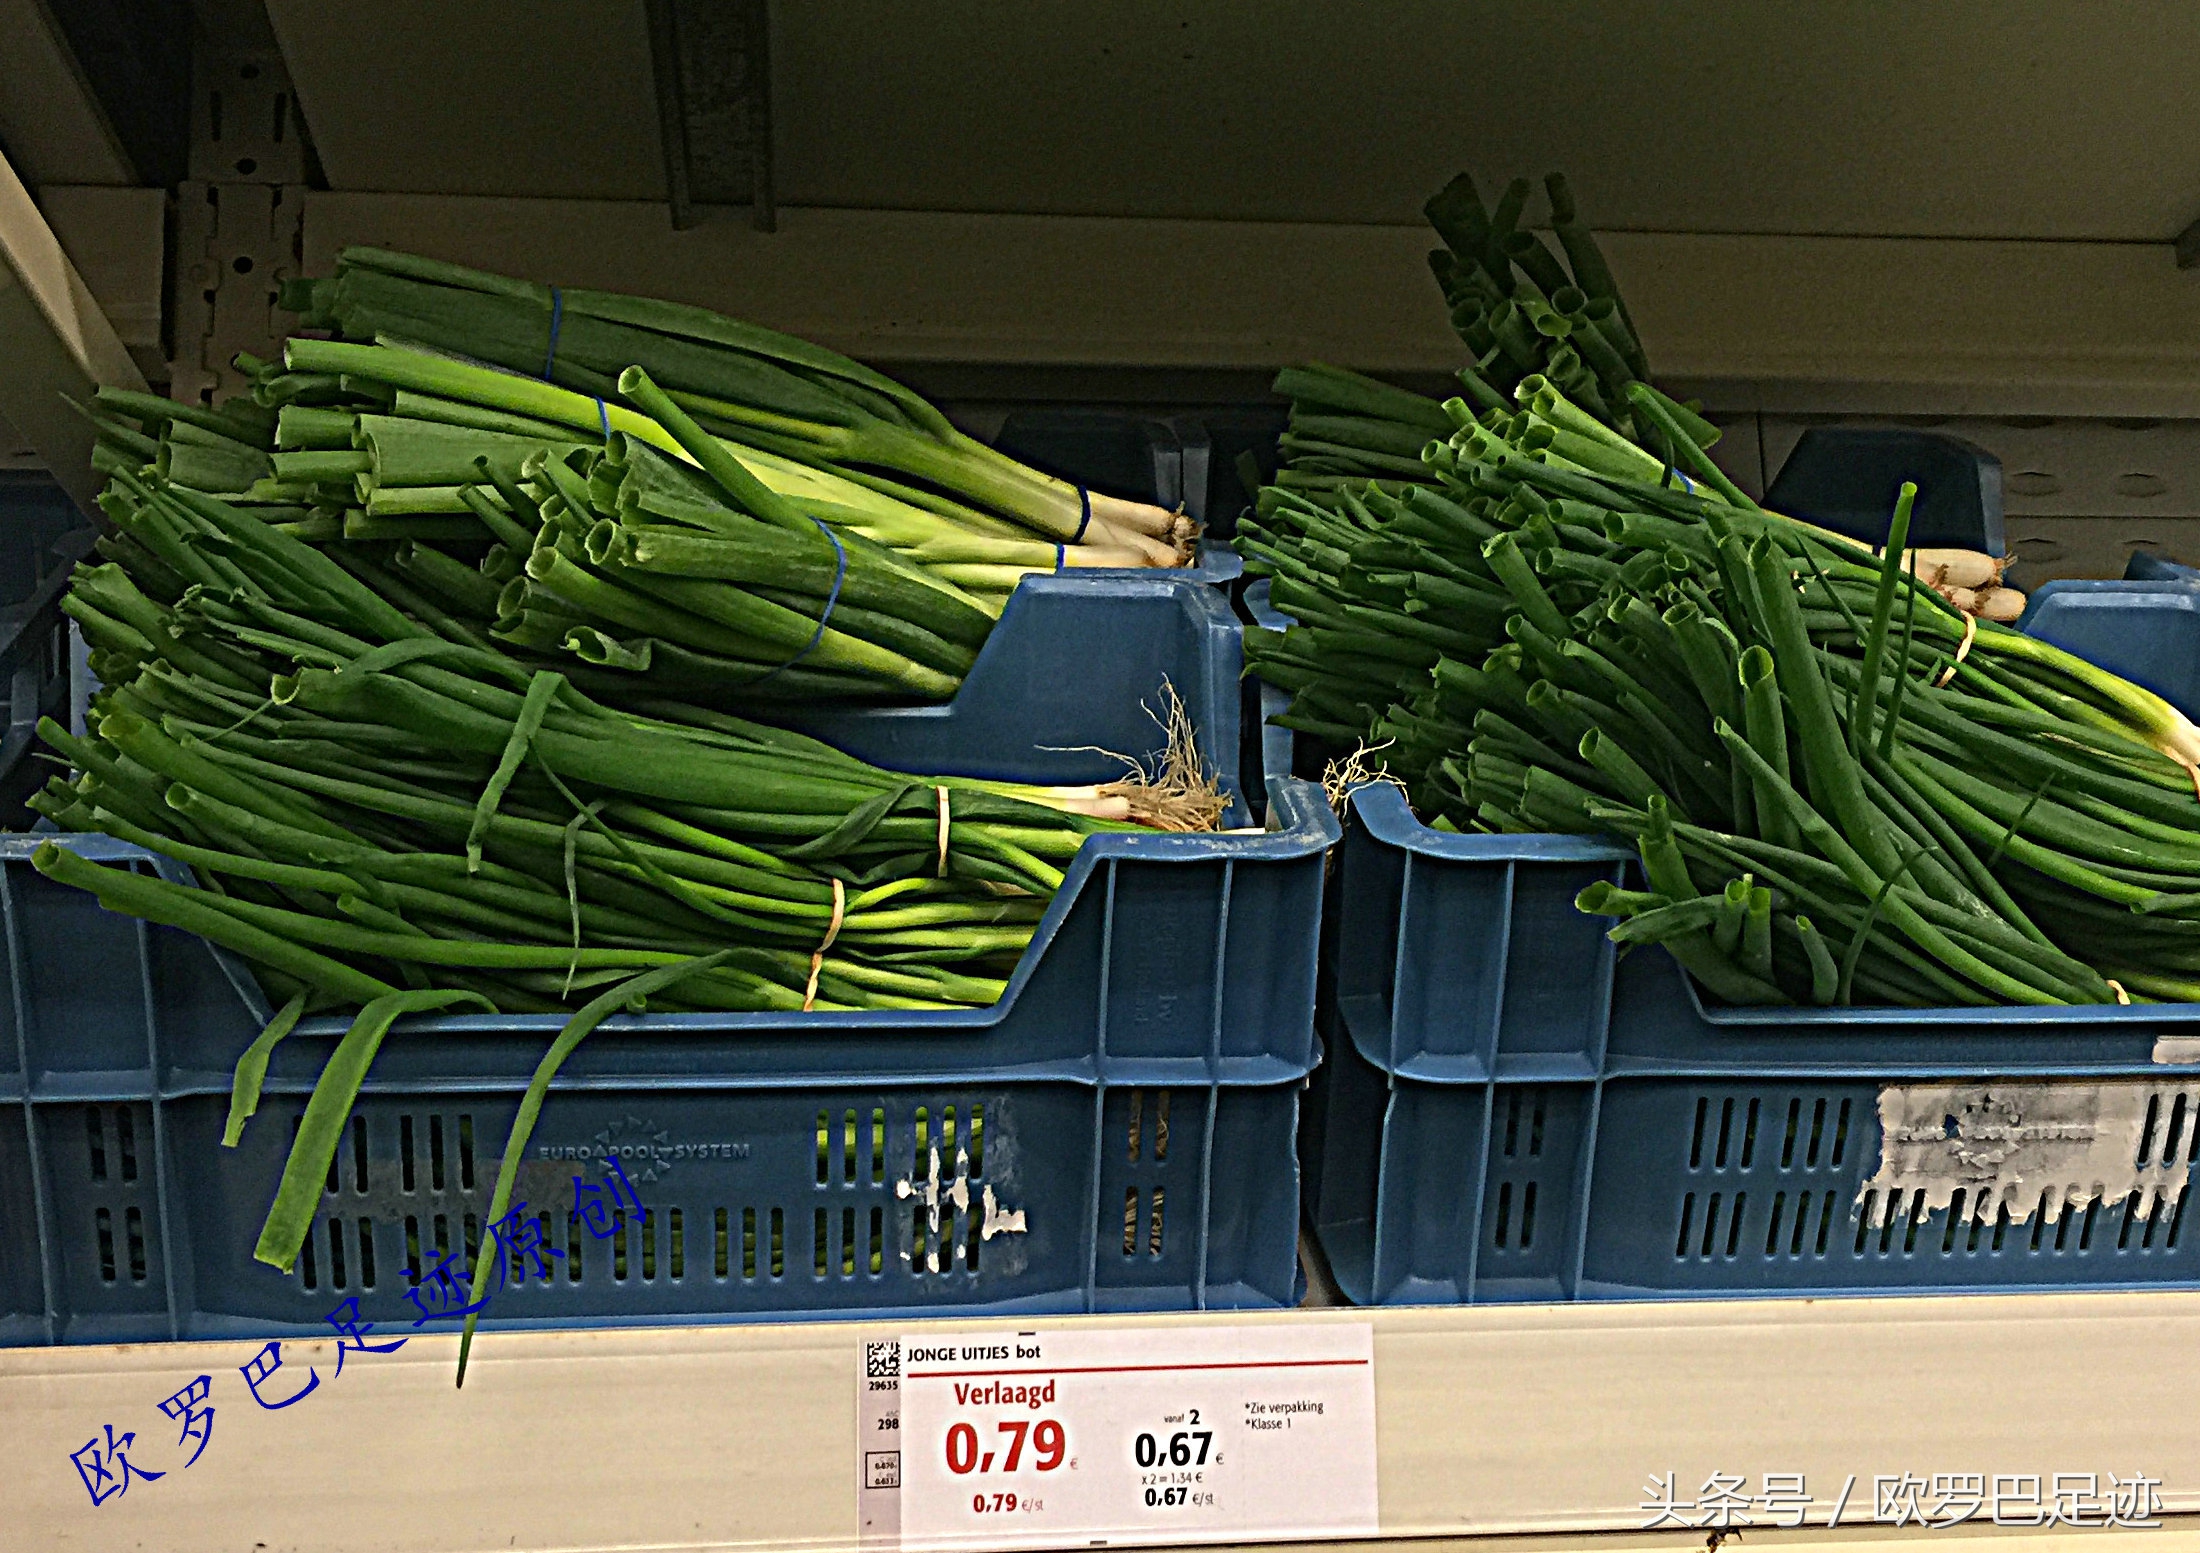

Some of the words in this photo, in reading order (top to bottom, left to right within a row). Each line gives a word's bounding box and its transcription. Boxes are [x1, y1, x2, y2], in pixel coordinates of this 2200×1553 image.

[540, 1145, 592, 1160] EURO
[607, 1145, 661, 1160] POOL
[675, 1143, 750, 1159] SYSTEM
[907, 1347, 957, 1362] JONGE
[962, 1346, 1009, 1360] UITJES
[1016, 1344, 1041, 1359] bot
[868, 1380, 899, 1391] 29635
[954, 1379, 1056, 1410] Verlaagd
[1269, 1400, 1324, 1415] verpakking
[878, 1418, 899, 1430] 298
[1189, 1409, 1200, 1425] 2
[946, 1419, 1066, 1474] 0,79
[1135, 1431, 1213, 1467] 0,67
[973, 1493, 1017, 1513] 0,79
[1145, 1487, 1188, 1506] 0,67
